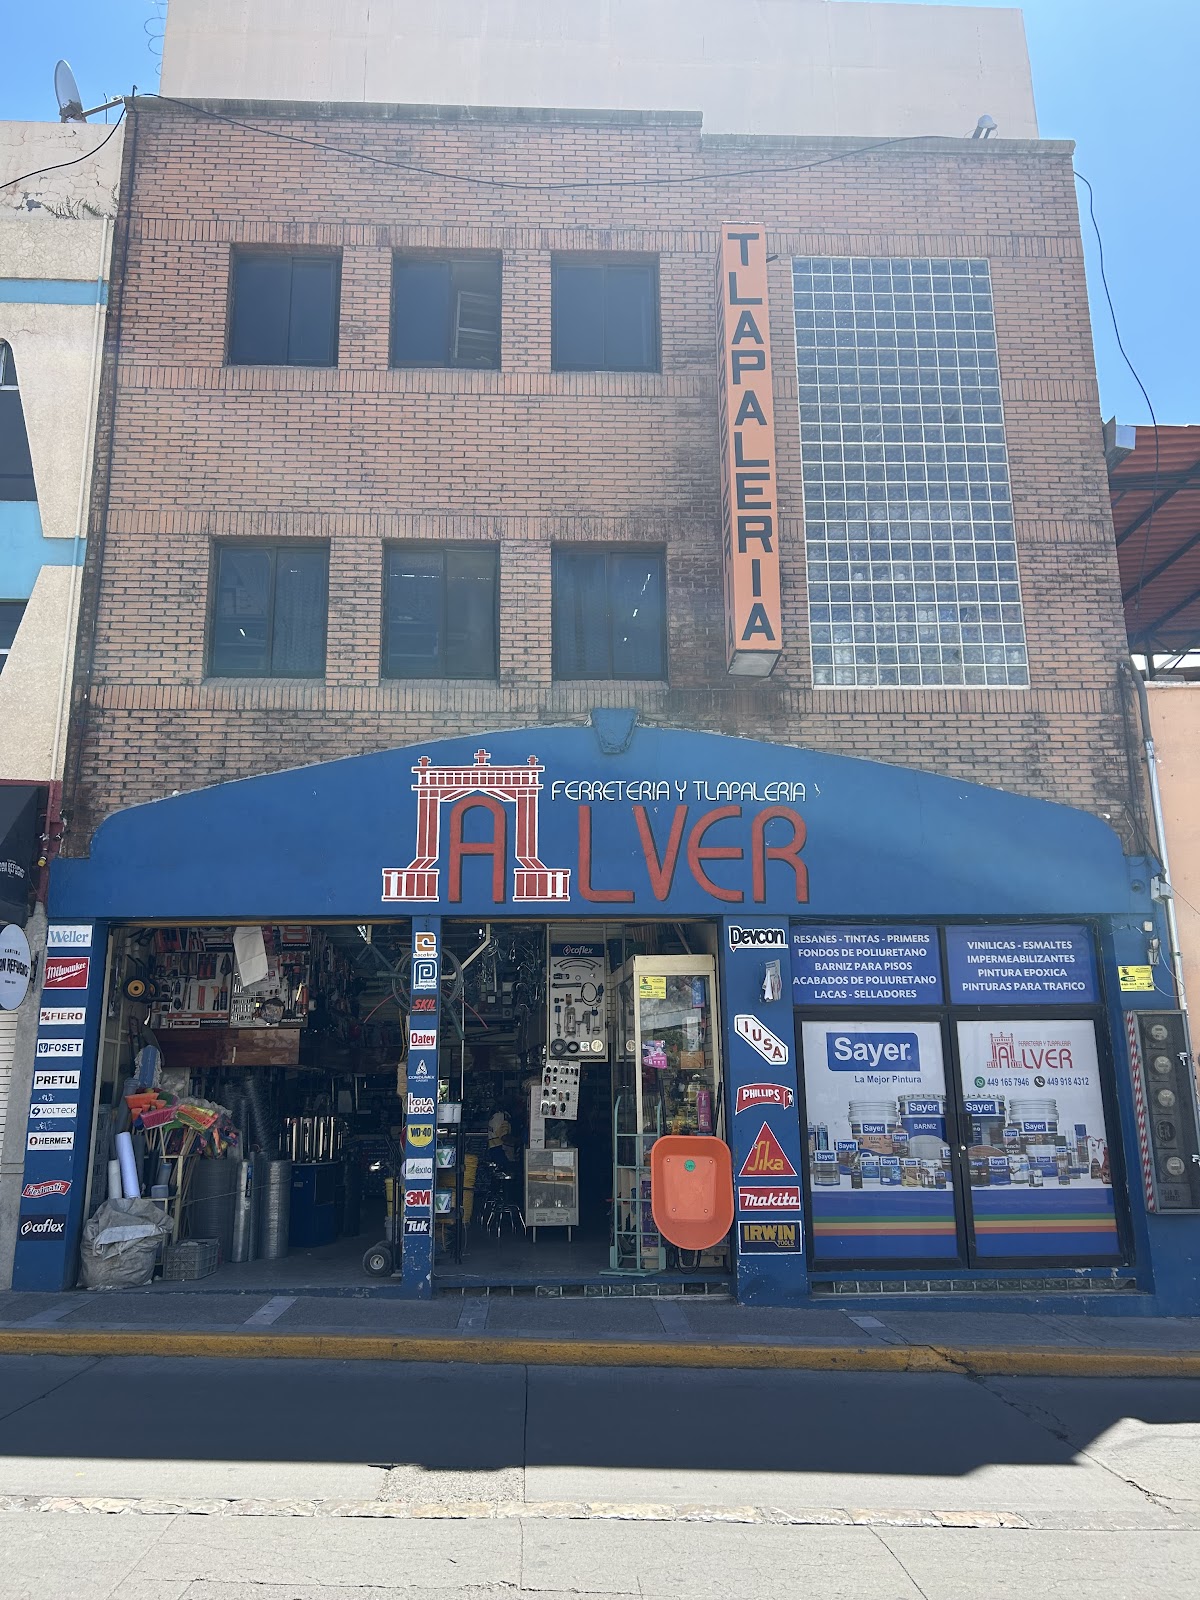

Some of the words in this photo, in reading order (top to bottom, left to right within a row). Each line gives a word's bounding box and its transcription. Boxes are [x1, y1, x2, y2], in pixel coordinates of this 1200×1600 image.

[727, 232, 776, 641] TLAPALERIA
[551, 780, 670, 801] FERRETERIA
[674, 780, 687, 801] Y
[692, 780, 806, 802] TLAPALERIA
[447, 795, 810, 904] ALVER
[50, 930, 89, 943] Weller
[730, 926, 784, 945] Devcon
[793, 934, 837, 944] RESANES
[844, 934, 880, 944] TINTAS
[887, 934, 930, 943] PRIMERS
[967, 941, 1016, 950] VINILICAS
[1023, 940, 1073, 950] ESMALTES
[571, 946, 594, 956] coflex
[798, 948, 839, 957] FONDOS
[841, 948, 855, 957] DE
[856, 948, 927, 957] POLIURETANO
[967, 954, 1076, 964] IMPERMEABILIZANTES
[46, 962, 87, 980] Milwaukee
[814, 962, 853, 971] BARNIZ
[854, 962, 883, 971] PARA
[884, 962, 913, 971] PISOS
[978, 968, 1022, 977] PINTURA
[1023, 968, 1067, 977] EPOXICA
[792, 976, 849, 985] ACABADOS
[850, 976, 864, 985] DE
[866, 975, 937, 985] POLIURETANO
[962, 982, 1012, 991] PINTURAS
[1013, 982, 1042, 991] PARA
[1043, 981, 1086, 991] TRAFICO
[814, 990, 847, 999] LACAS
[854, 989, 917, 998] SELLADORES
[412, 999, 436, 1009] SKIL
[51, 1012, 83, 1020] FIERO
[411, 1032, 436, 1044] Oatey
[744, 1020, 783, 1059] IUSA
[48, 1043, 82, 1052] FOSET
[834, 1036, 911, 1067] Sayer
[997, 1046, 1073, 1069] ALVER
[36, 1075, 78, 1085] PRETUL
[854, 1075, 865, 1083] La
[867, 1075, 890, 1085] Mejor
[892, 1075, 922, 1083] Pintura
[987, 1078, 999, 1087] 449
[1001, 1078, 1013, 1086] 165
[1014, 1077, 1030, 1086] 7946
[1047, 1077, 1059, 1086] 449
[1060, 1077, 1072, 1086] 918
[1074, 1077, 1090, 1086] 4312
[742, 1088, 780, 1101] PHILLIPS
[408, 1105, 434, 1114] LOKA
[910, 1102, 937, 1113] Sayer
[965, 1102, 993, 1114] Sayer
[863, 1124, 884, 1132] Sayer
[1024, 1122, 1045, 1131] Sayer
[410, 1127, 431, 1137] WD-40
[38, 1136, 72, 1145] HERMEX
[838, 1142, 855, 1151] Sayer
[747, 1140, 784, 1171] Sika
[817, 1152, 834, 1161] Sayer
[883, 1158, 897, 1166] Sayer
[990, 1157, 1005, 1166] Sayer
[406, 1190, 431, 1206] 3M
[32, 1218, 64, 1233] coflex
[406, 1220, 429, 1232] Tuk
[744, 1224, 795, 1241] IRWIN
